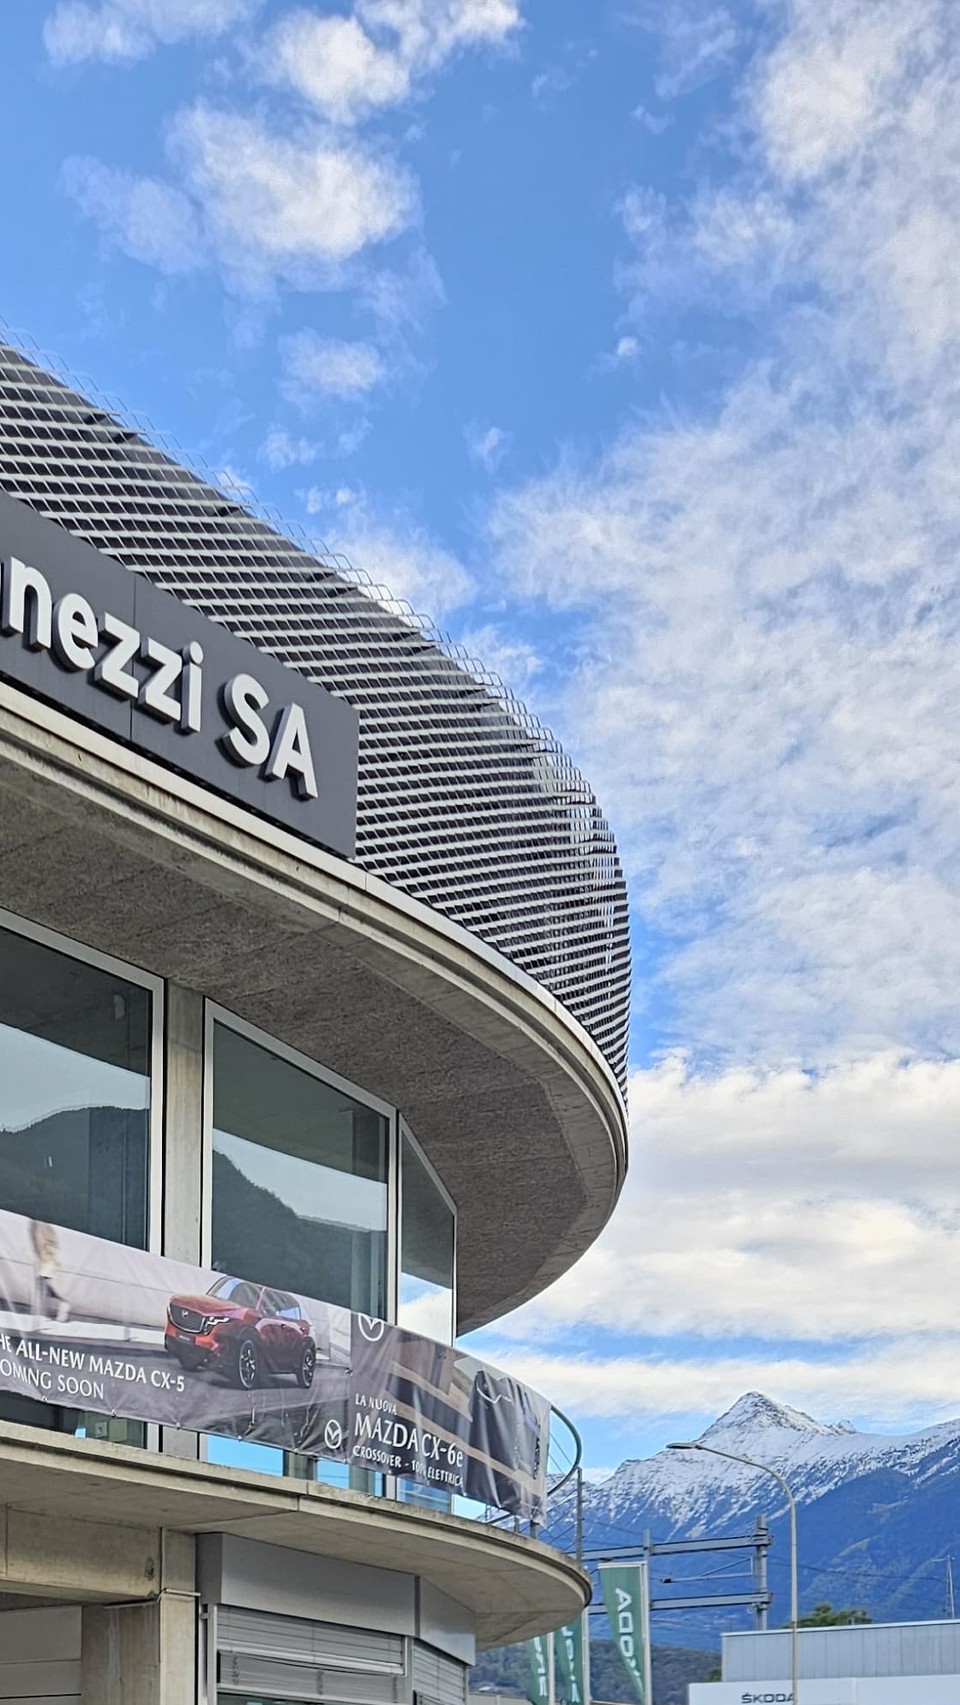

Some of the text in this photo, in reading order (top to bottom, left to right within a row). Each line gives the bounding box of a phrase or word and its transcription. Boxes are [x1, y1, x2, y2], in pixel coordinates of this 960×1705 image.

[220, 672, 319, 799] SA
[16, 1341, 85, 1370] ALL-NEW
[89, 1356, 146, 1384] MAZDA
[151, 1370, 185, 1392] CX-5
[57, 1375, 104, 1399] SOON
[355, 1393, 366, 1407] LA
[354, 1412, 464, 1467] MAZDA CX-6e
[427, 1466, 464, 1488] ELETTRICA
